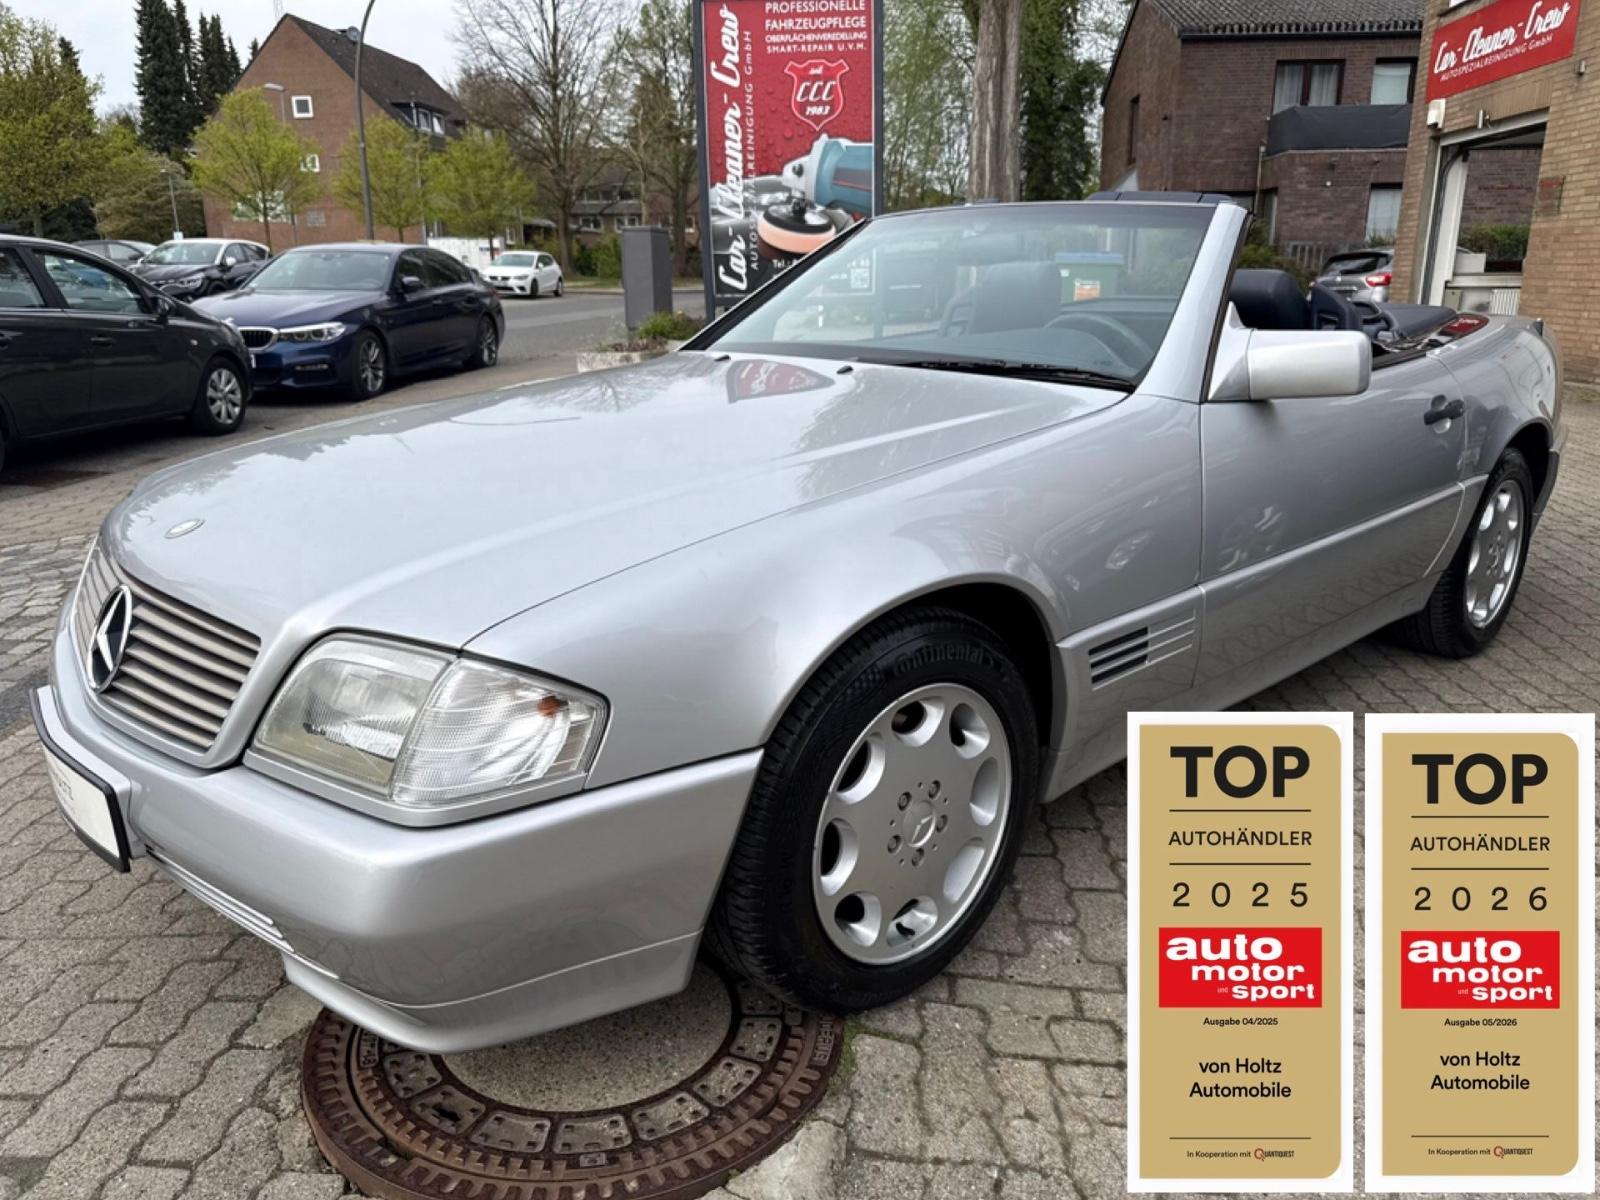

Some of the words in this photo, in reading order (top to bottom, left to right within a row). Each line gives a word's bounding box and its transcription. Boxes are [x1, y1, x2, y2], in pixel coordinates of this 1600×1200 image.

[765, 0, 865, 13] PROFESSIONELLE
[765, 16, 866, 31] FAHRZEUGPFLEGE
[709, 4, 740, 88] Crew
[743, 31, 752, 75] GmbH
[1434, 41, 1457, 74] Car
[1462, 26, 1517, 63] Cleaner
[1524, 1, 1571, 39] Crew
[796, 81, 837, 102] CCC
[716, 102, 743, 220] Cleaner
[718, 234, 747, 291] Car
